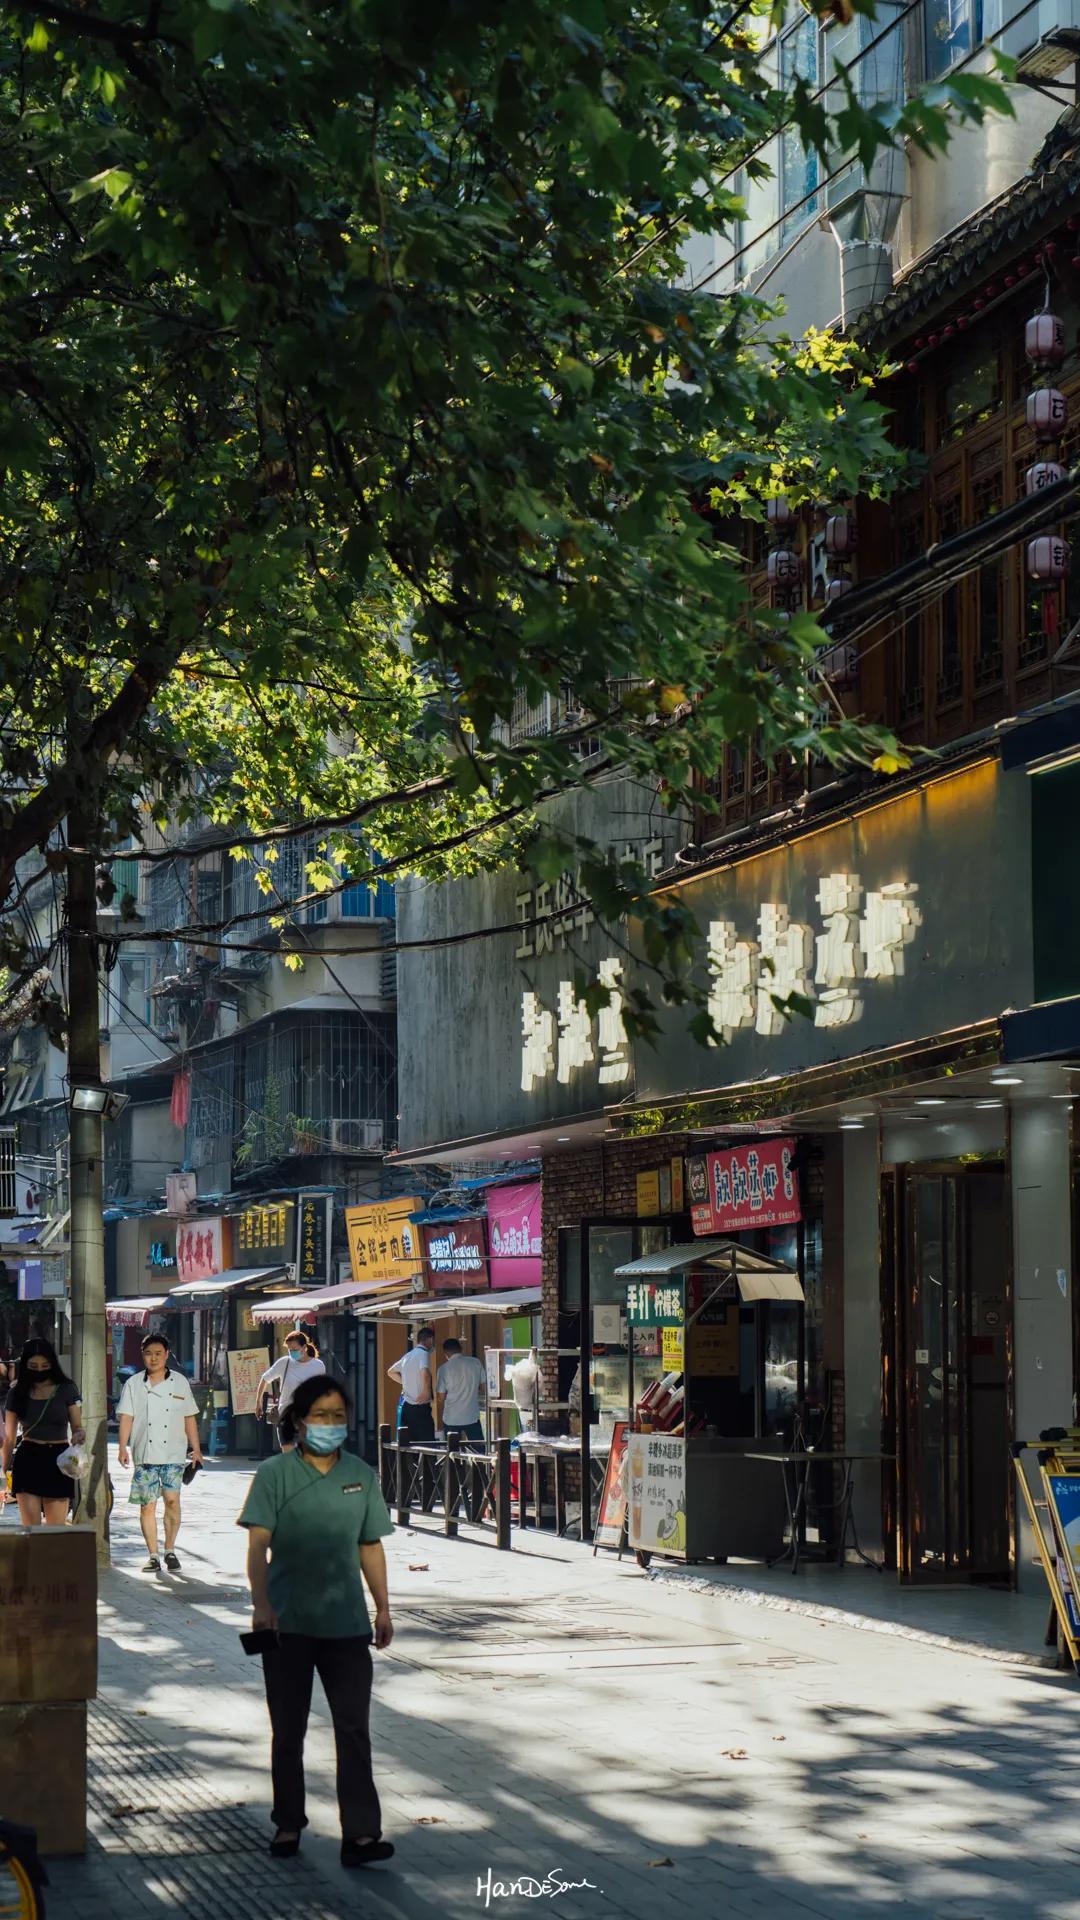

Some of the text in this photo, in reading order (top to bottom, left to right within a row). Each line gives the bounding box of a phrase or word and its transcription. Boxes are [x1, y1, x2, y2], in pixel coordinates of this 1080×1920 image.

[706, 873, 923, 1047] 靓靓蒸虾
[714, 1150, 778, 1213] 靓靓蒸虾
[627, 1284, 681, 1320] 手打 柠檬茶
